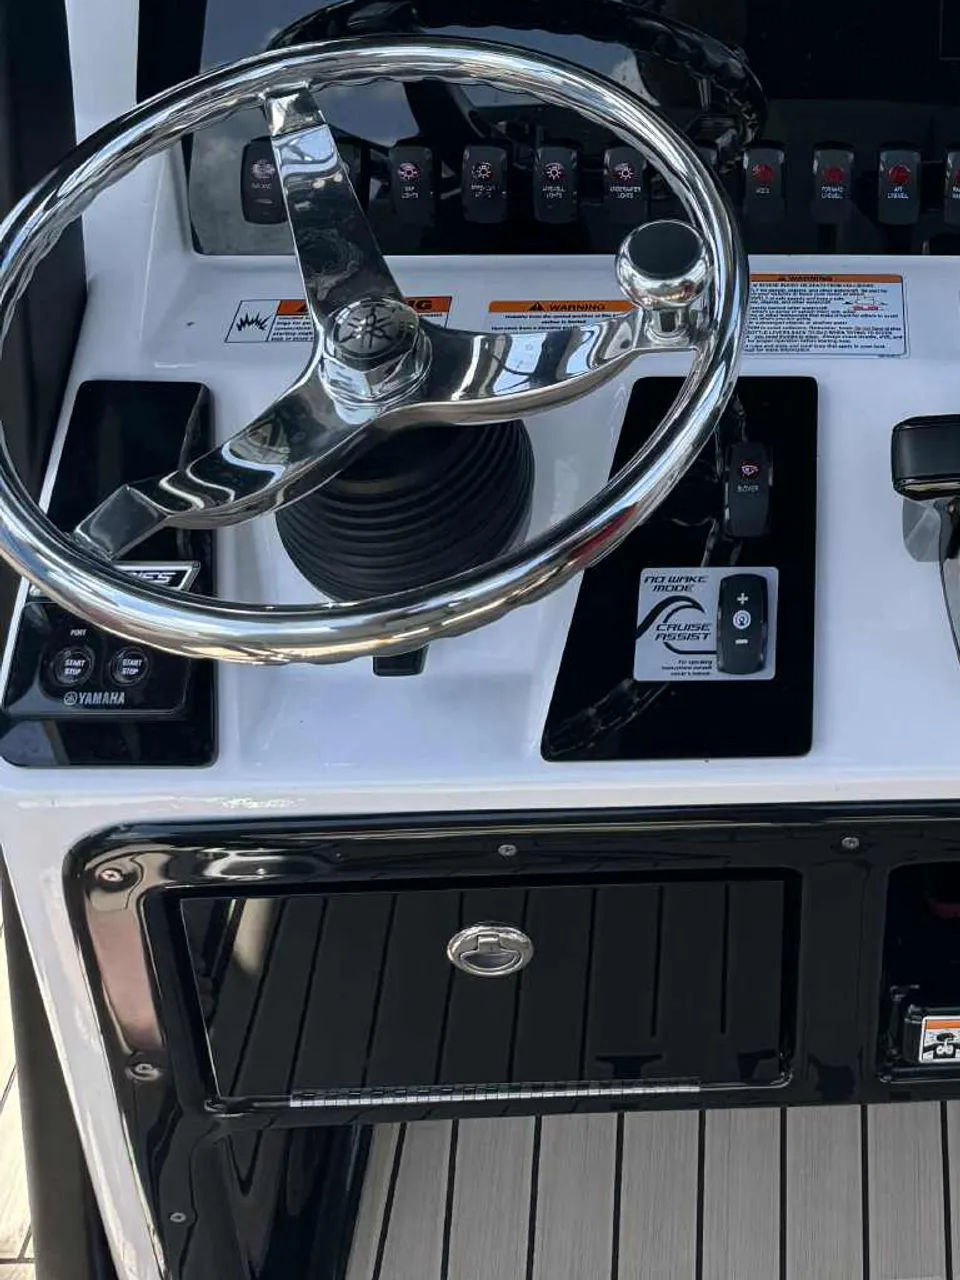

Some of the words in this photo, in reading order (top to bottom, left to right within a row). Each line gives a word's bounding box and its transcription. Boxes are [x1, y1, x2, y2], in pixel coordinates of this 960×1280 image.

[550, 304, 606, 312] WARNING
[644, 575, 664, 583] NO
[667, 575, 709, 583] WAKE
[653, 584, 695, 593] MODE
[656, 623, 712, 632] CRUISE
[70, 629, 87, 637] PORT
[655, 632, 712, 641] ASSIST
[64, 659, 86, 667] START
[122, 659, 142, 667] START
[64, 668, 82, 676] STOP
[121, 667, 139, 676] STOP
[78, 691, 125, 705] YAMAHA
